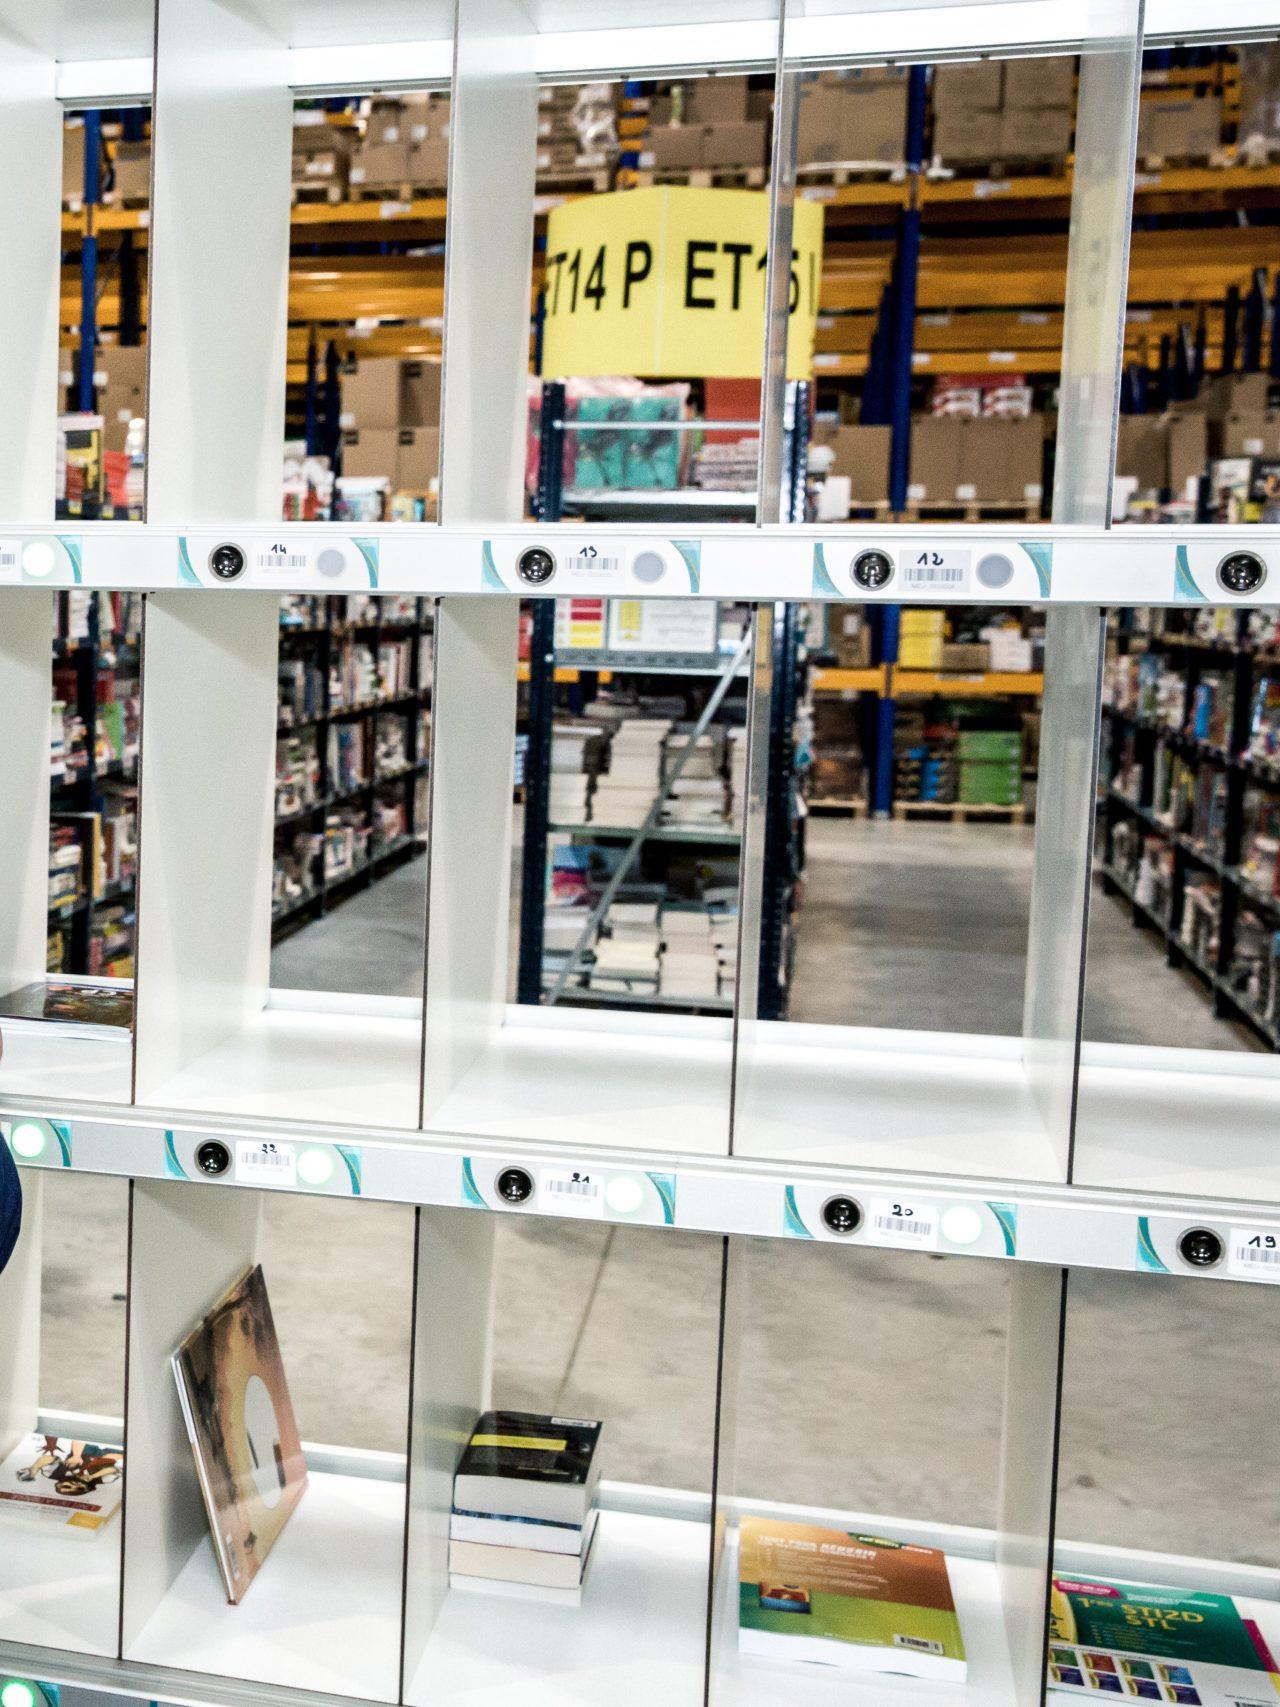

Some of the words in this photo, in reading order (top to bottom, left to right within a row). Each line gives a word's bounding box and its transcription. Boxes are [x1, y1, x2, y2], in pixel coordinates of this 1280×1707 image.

[545, 244, 606, 316] T14
[622, 240, 653, 309] P
[270, 543, 287, 554] 14
[579, 545, 598, 558] 13
[917, 552, 944, 566] 12
[261, 1143, 277, 1154] 22
[571, 1172, 590, 1183] 21
[891, 1203, 914, 1217] 20
[1248, 1235, 1276, 1249] 19
